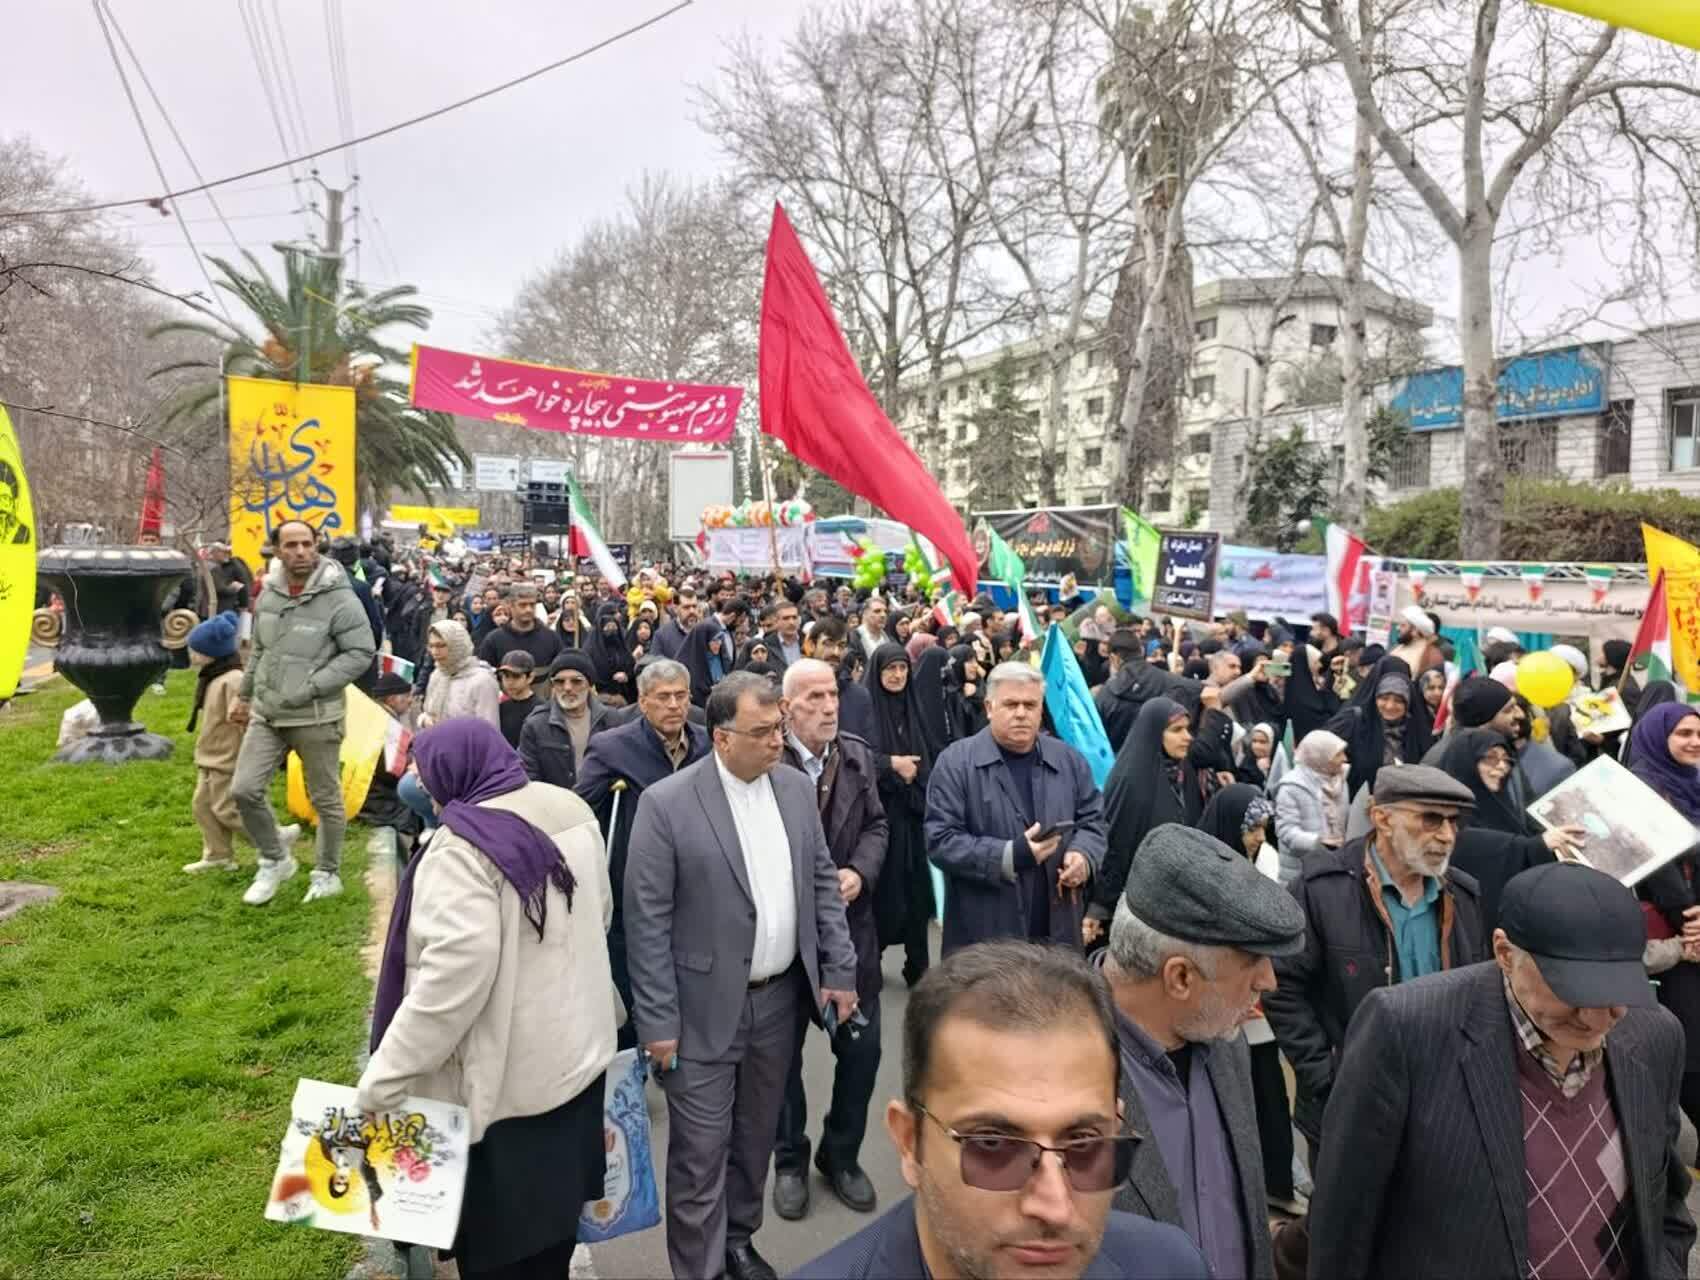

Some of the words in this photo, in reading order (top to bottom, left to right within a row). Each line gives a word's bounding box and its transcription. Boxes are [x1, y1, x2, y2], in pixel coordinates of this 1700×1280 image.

[452, 360, 484, 390] شد
[470, 378, 562, 413] خواهد
[562, 391, 607, 431] بیچاره
[602, 384, 698, 431] صهیونیستی
[687, 394, 727, 434] رژیم
